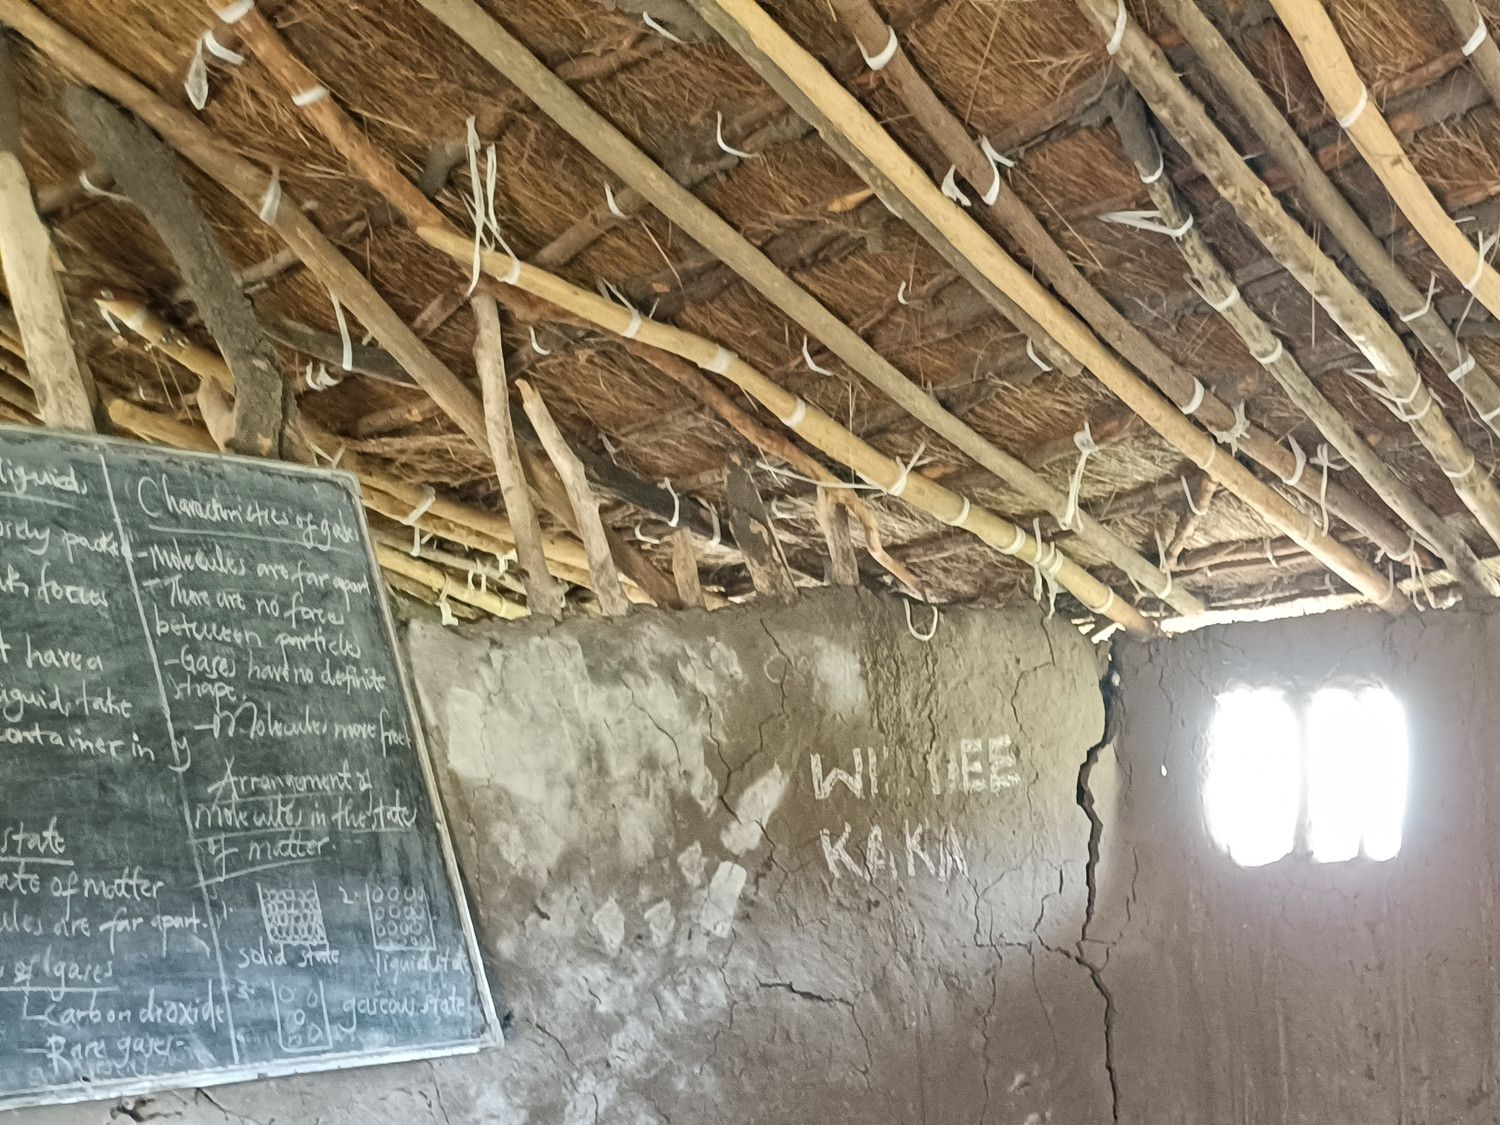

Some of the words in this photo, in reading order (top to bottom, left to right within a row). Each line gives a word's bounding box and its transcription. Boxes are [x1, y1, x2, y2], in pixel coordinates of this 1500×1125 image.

[254, 596, 280, 618] no
[26, 632, 82, 671] have
[132, 731, 156, 762] in
